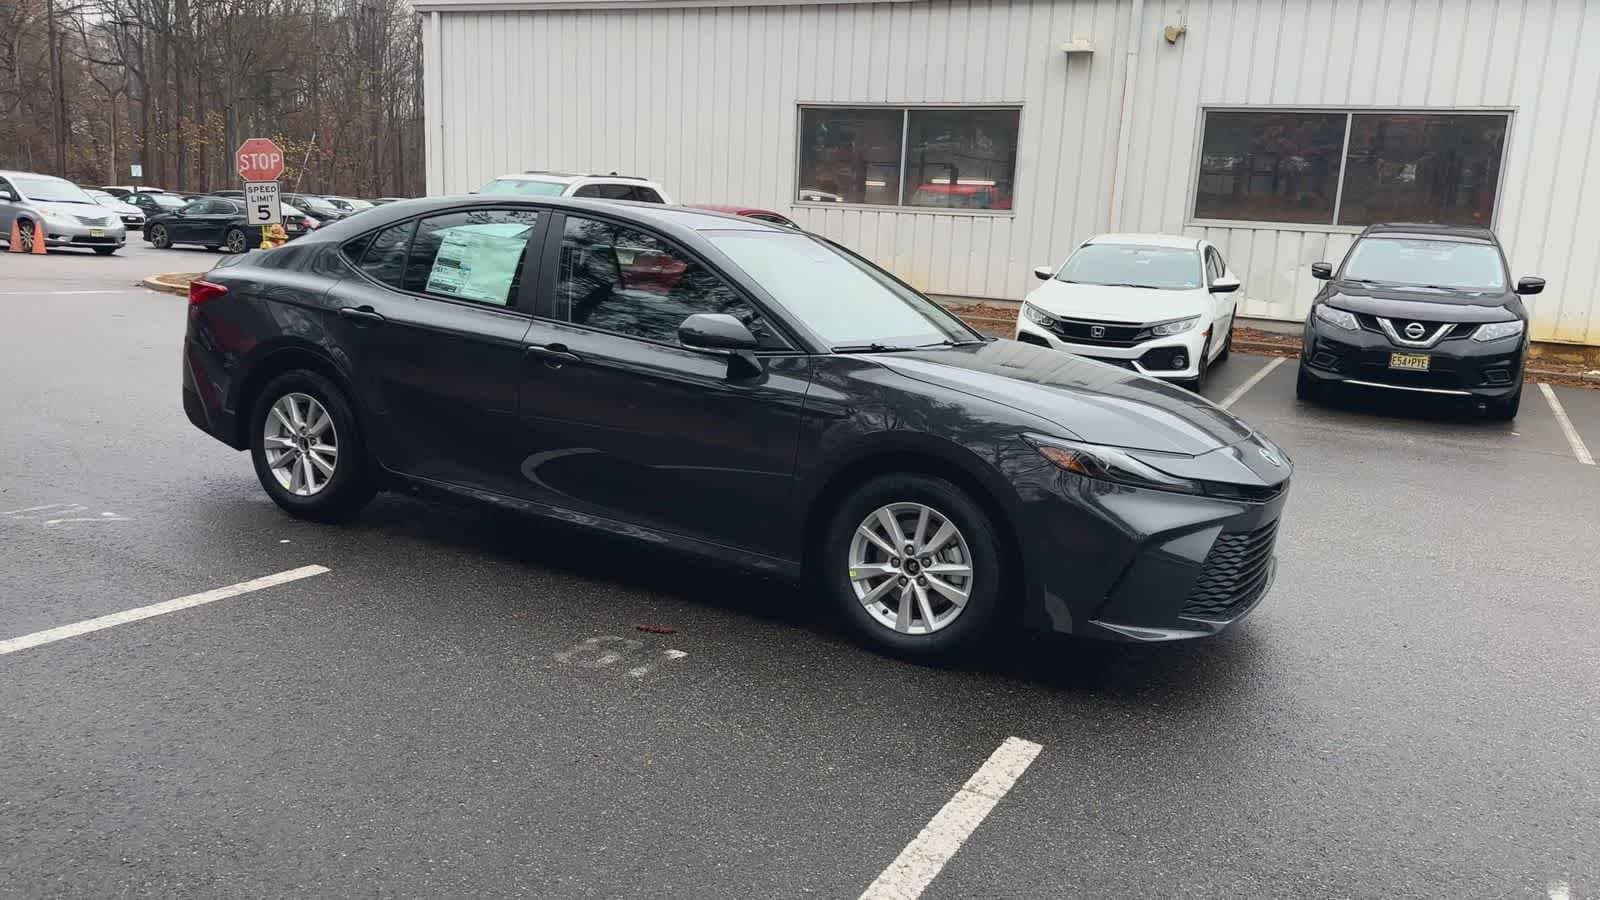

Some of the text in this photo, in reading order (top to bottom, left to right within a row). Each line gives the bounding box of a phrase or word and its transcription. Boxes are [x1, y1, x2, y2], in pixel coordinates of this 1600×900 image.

[240, 153, 280, 170] STOP
[247, 185, 277, 194] SPEED
[251, 195, 274, 203] LIMIT
[258, 204, 271, 221] 5
